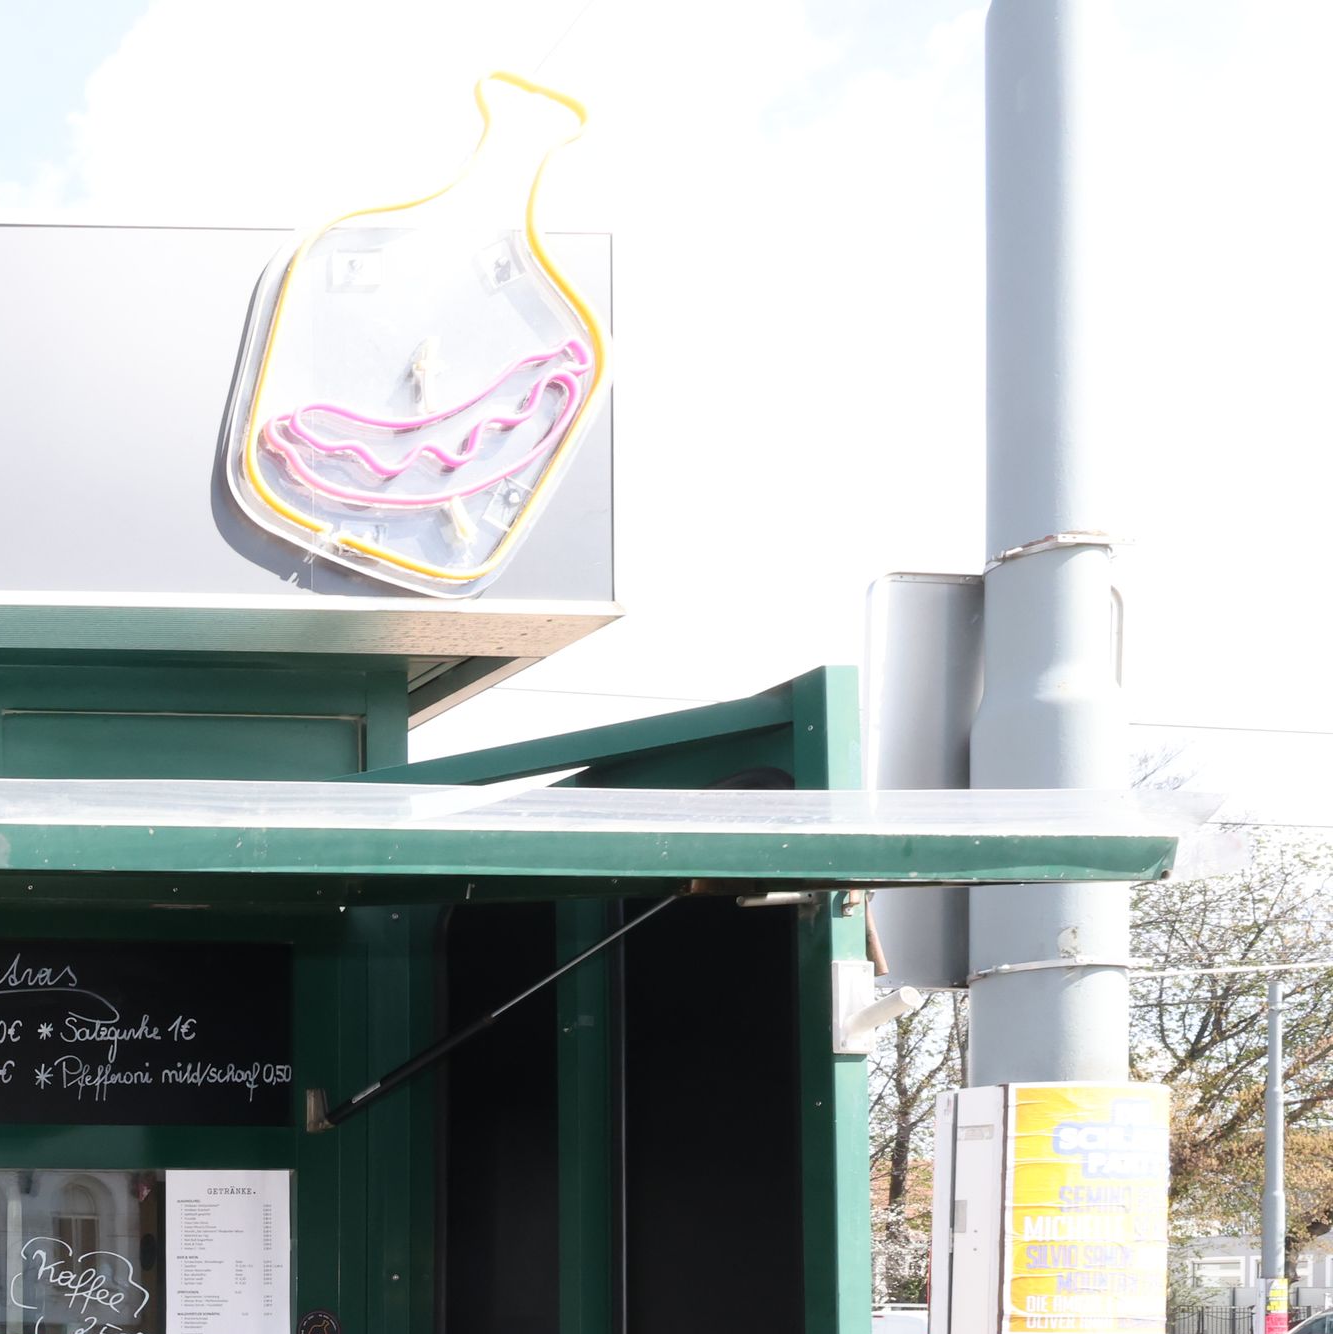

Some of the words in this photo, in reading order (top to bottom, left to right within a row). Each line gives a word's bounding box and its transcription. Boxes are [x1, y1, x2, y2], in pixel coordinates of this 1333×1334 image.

[60, 1015, 162, 1063] Salzgurke
[54, 1055, 153, 1101] Pfefferoni
[206, 1185, 257, 1196] GETRÄNKE.
[33, 1250, 124, 1314] Kaffee
